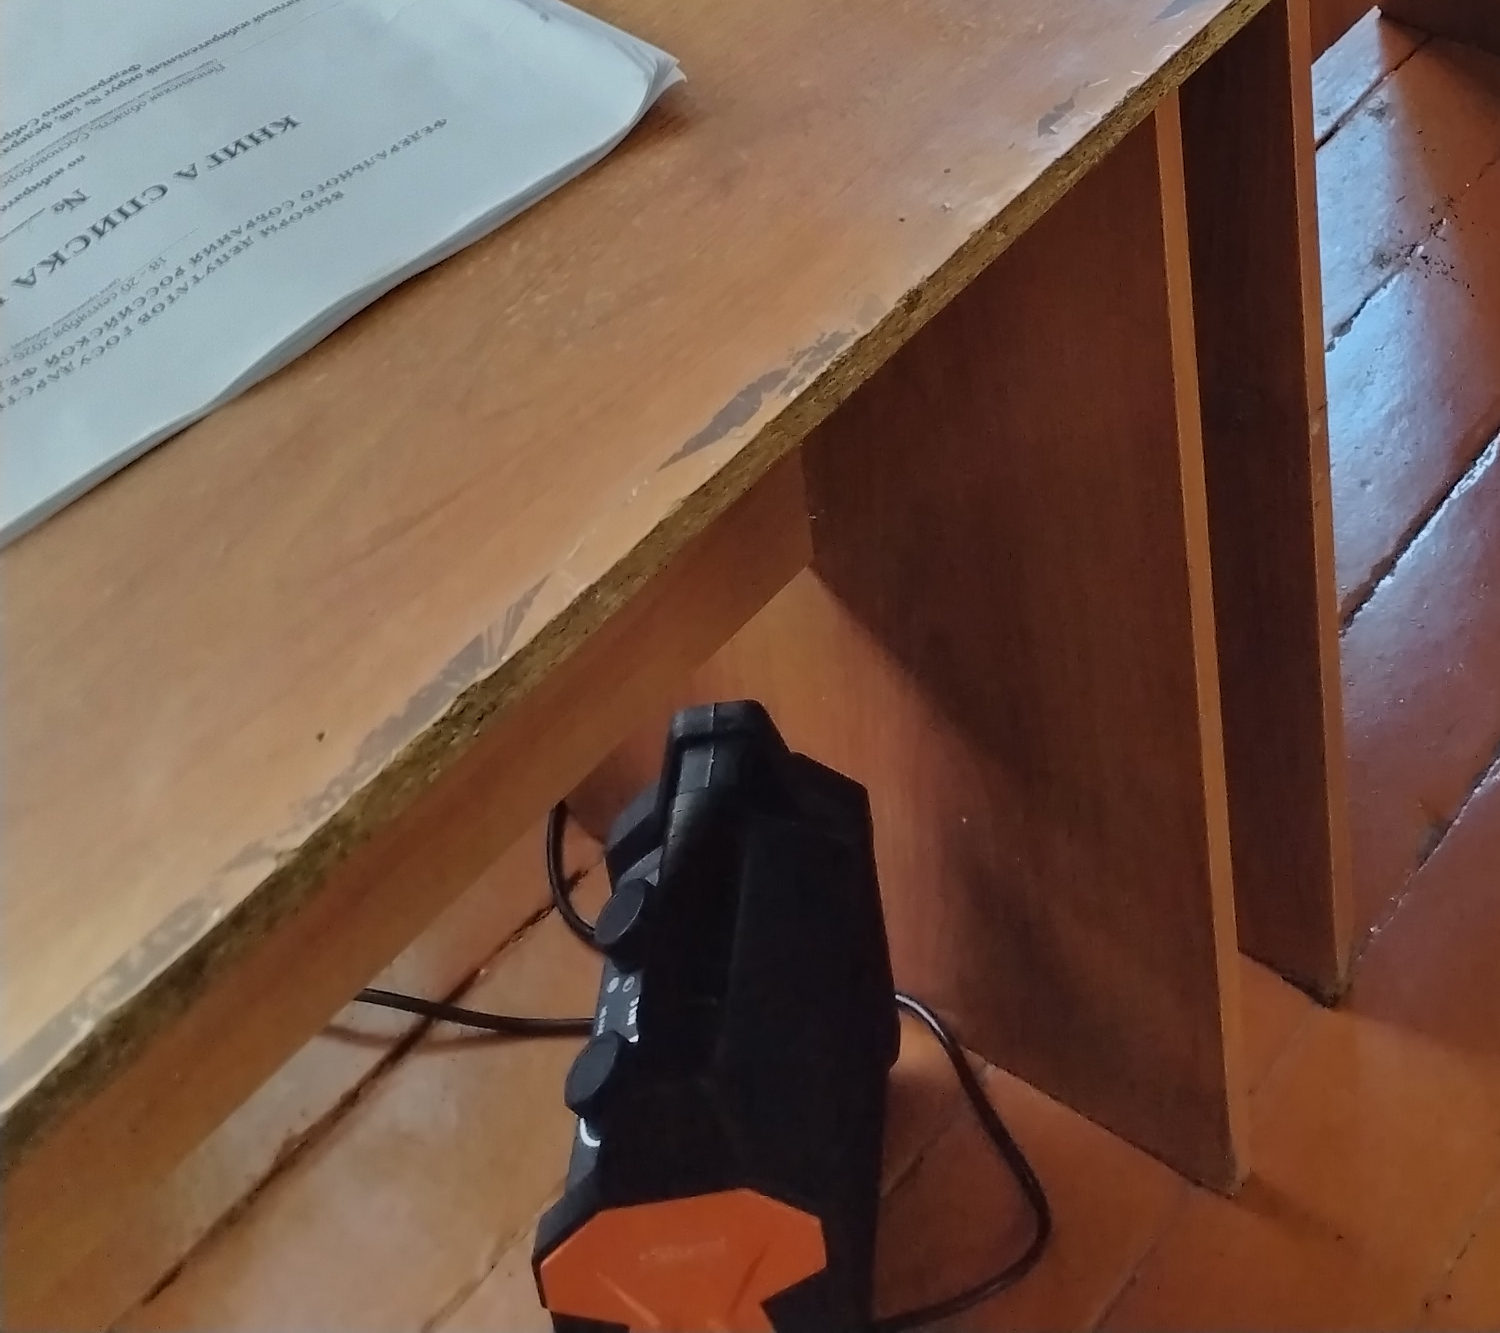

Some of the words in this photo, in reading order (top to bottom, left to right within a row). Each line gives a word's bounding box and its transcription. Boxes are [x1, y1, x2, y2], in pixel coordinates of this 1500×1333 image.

[0, 121, 53, 156] федера
[170, 112, 300, 181] КНИГА
[298, 115, 449, 204] ФЕДЕРАЛЬНОГО
[7, 178, 172, 290] СПИСКА
[51, 188, 91, 215] №
[186, 196, 297, 268] СОБРАНИЯ
[258, 187, 346, 240] ВЫБОРЫ
[53, 292, 118, 339] сентября
[119, 277, 139, 296] 20
[134, 234, 255, 328] ДЕПУТАТОВ
[42, 263, 186, 371] РОССИЙСКОЙ
